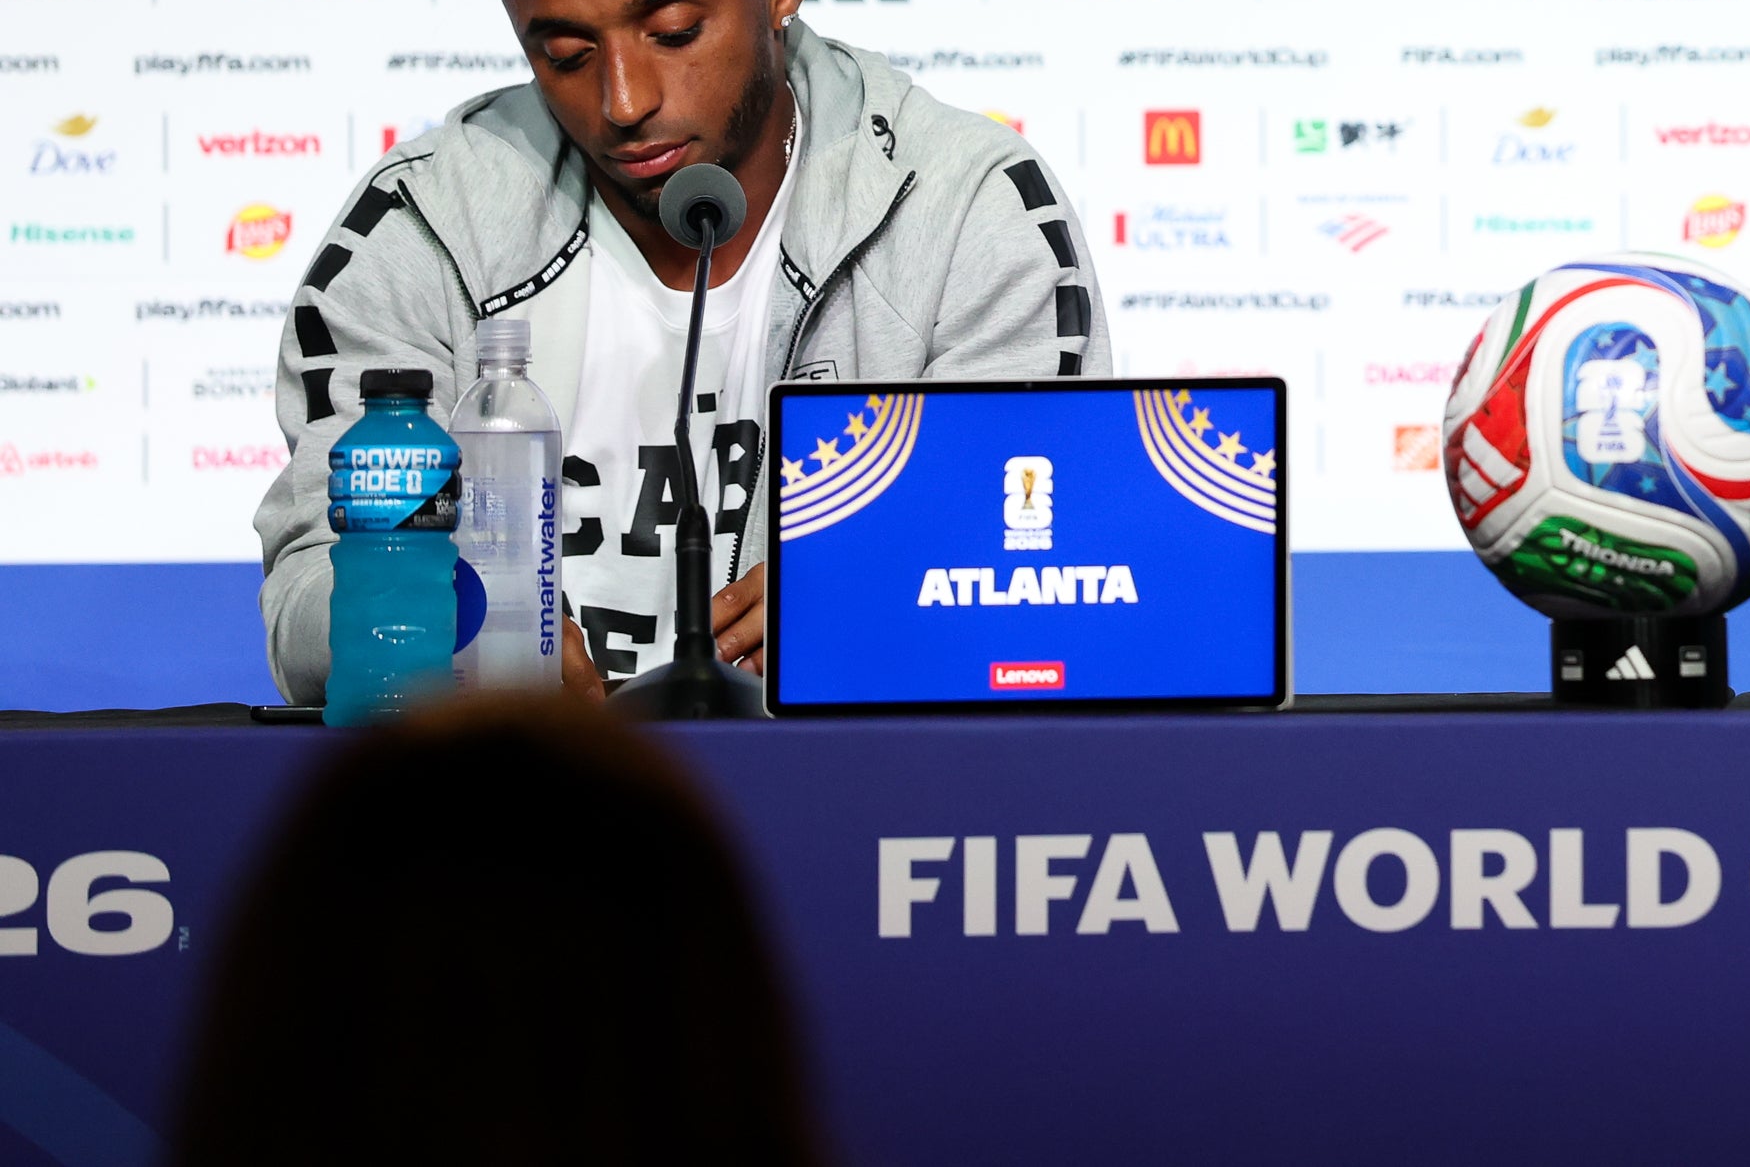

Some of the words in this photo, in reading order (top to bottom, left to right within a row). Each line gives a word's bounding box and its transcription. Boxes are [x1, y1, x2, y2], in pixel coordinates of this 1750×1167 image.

[30, 141, 115, 175] Dove
[198, 130, 321, 156] verizon
[1492, 135, 1576, 165] Dove
[10, 224, 135, 243] Hisense
[351, 449, 442, 470] POWER
[350, 470, 401, 492] ADE
[538, 477, 555, 656] smartwater
[1559, 527, 1675, 576] TRIONDA
[917, 566, 1139, 607] ATLANTA
[996, 667, 1058, 684] Lenovo
[878, 834, 1179, 937] FIFA
[1203, 826, 1722, 932] WORLD
